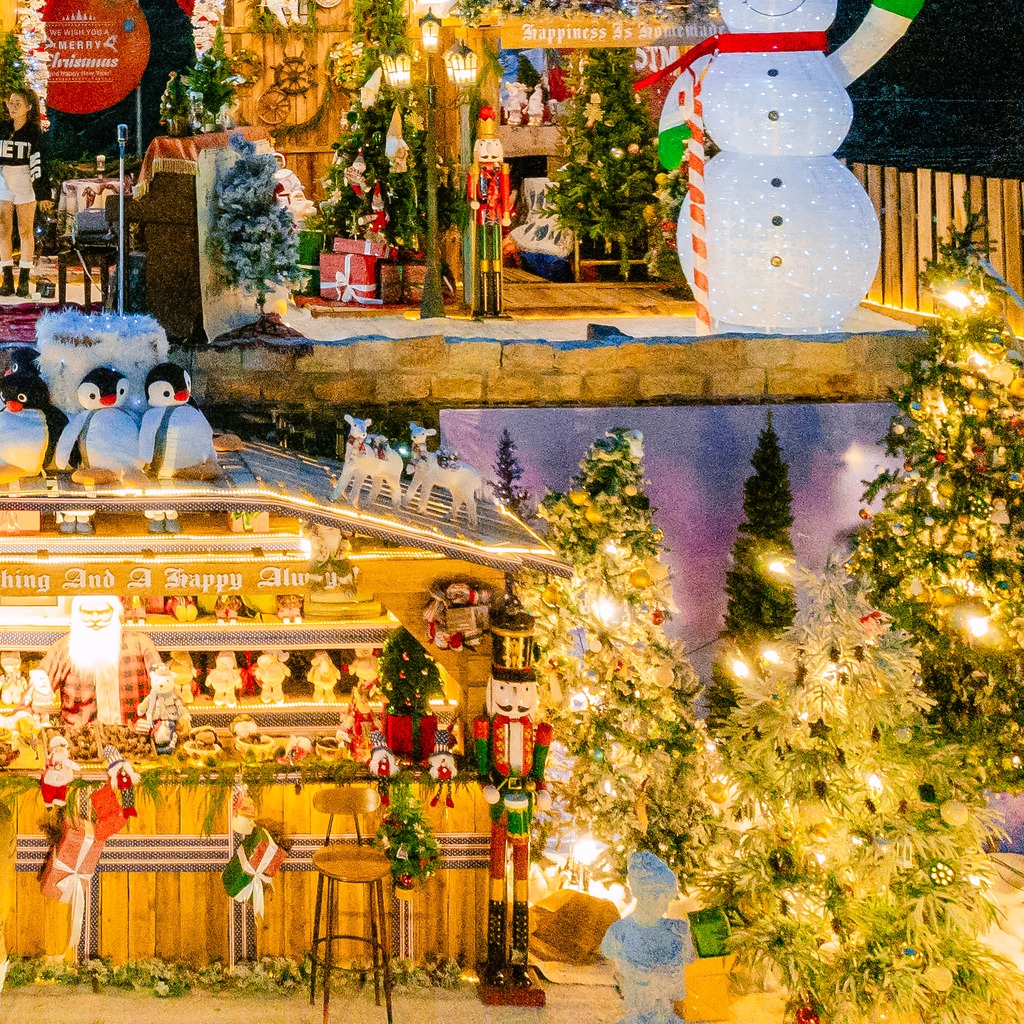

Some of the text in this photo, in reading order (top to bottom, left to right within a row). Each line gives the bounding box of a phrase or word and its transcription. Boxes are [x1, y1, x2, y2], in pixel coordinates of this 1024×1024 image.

[86, 28, 103, 36] YOU
[522, 22, 607, 45] Happiness
[613, 21, 633, 41] Is
[58, 40, 102, 50] MERRY
[61, 567, 115, 590] And
[127, 567, 153, 590] A
[164, 567, 243, 594] Happy
